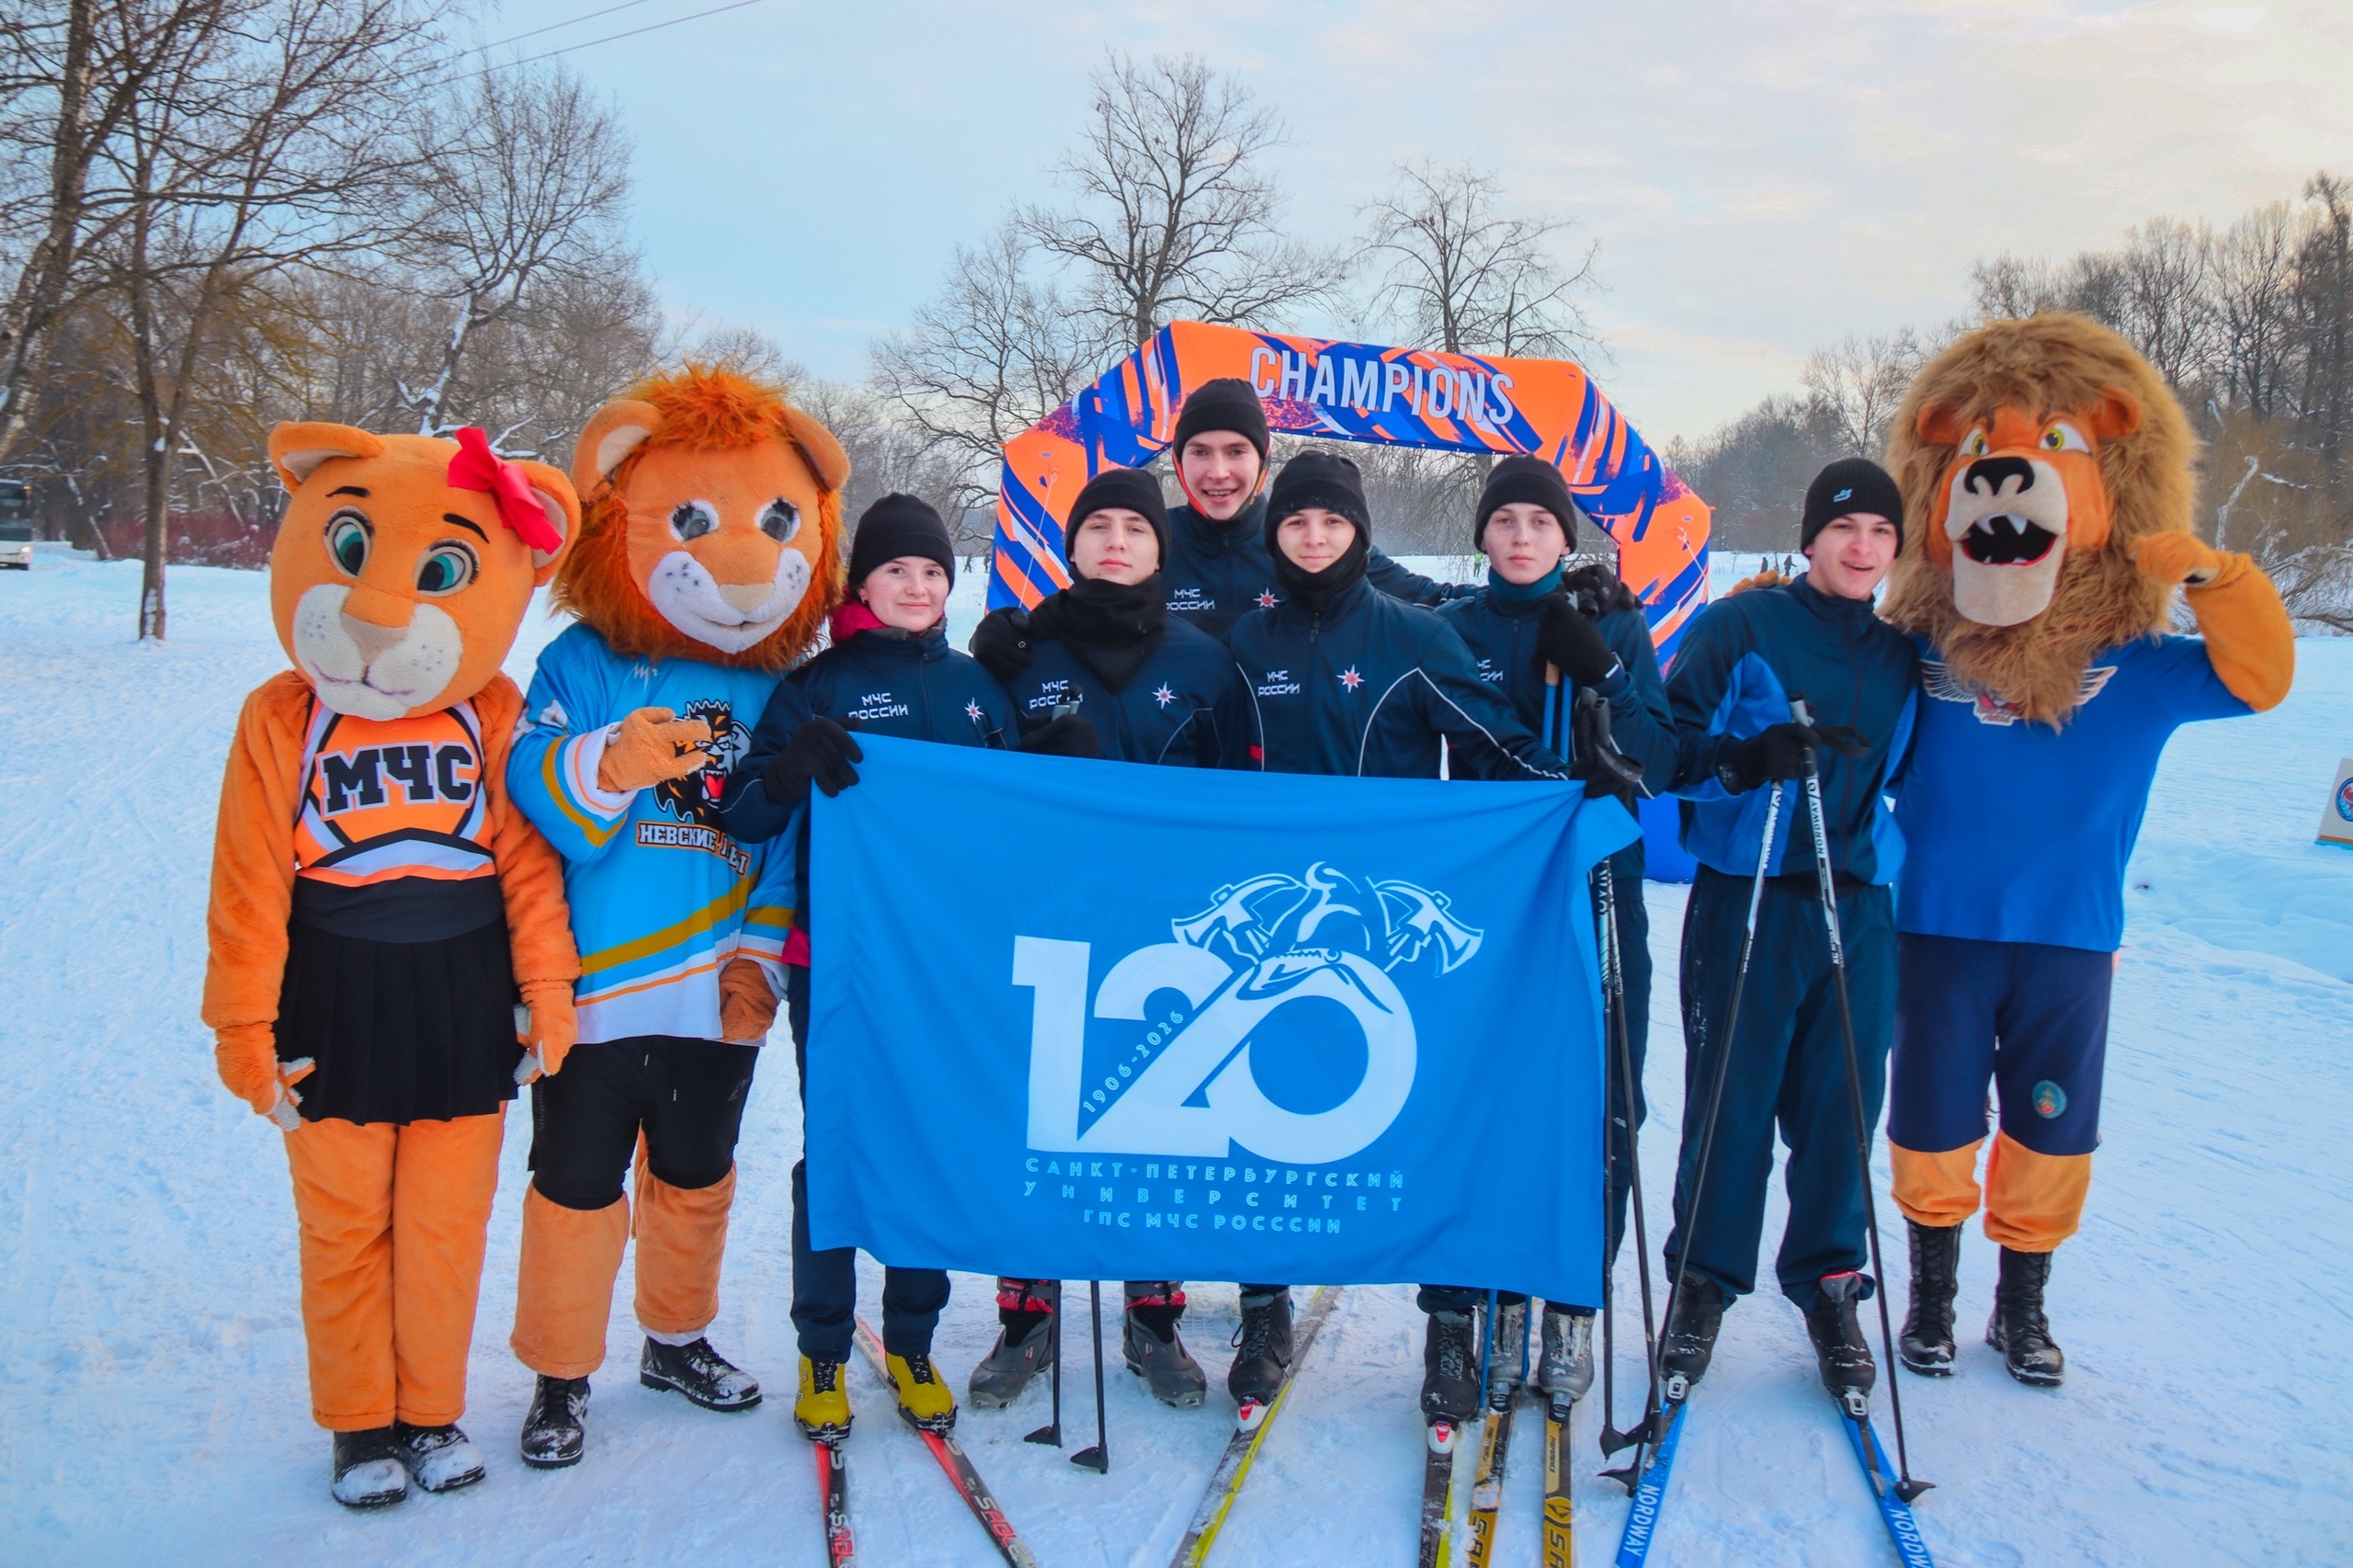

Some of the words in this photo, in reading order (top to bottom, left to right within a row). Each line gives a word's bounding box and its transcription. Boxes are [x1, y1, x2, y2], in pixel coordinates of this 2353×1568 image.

[1250, 346, 1515, 426] CHAMPIONS
[1175, 588, 1200, 599] МЧС
[1267, 670, 1289, 683] МЧС
[1476, 659, 1491, 669] ЧС
[861, 692, 892, 707] МЧС
[1041, 679, 1069, 693] МЧС
[1257, 683, 1301, 697] РОССИИ
[320, 742, 474, 816] МЧС
[639, 824, 717, 851] НЕВСКИЕ
[1012, 934, 1417, 1165] 120
[1083, 1010, 1184, 1113] 1906-2026
[1025, 1157, 1404, 1188] САНКТ-ПЕТЕРБУРГСКИЙ
[1024, 1181, 1402, 1211] УНИВЕРСИТЕТ
[1084, 1209, 1131, 1228] ГПС
[1145, 1213, 1199, 1229] МЧС
[1214, 1214, 1341, 1233] РОСССИИ
[1623, 1483, 1661, 1557] NORDWAY
[828, 1511, 854, 1568] SABL
